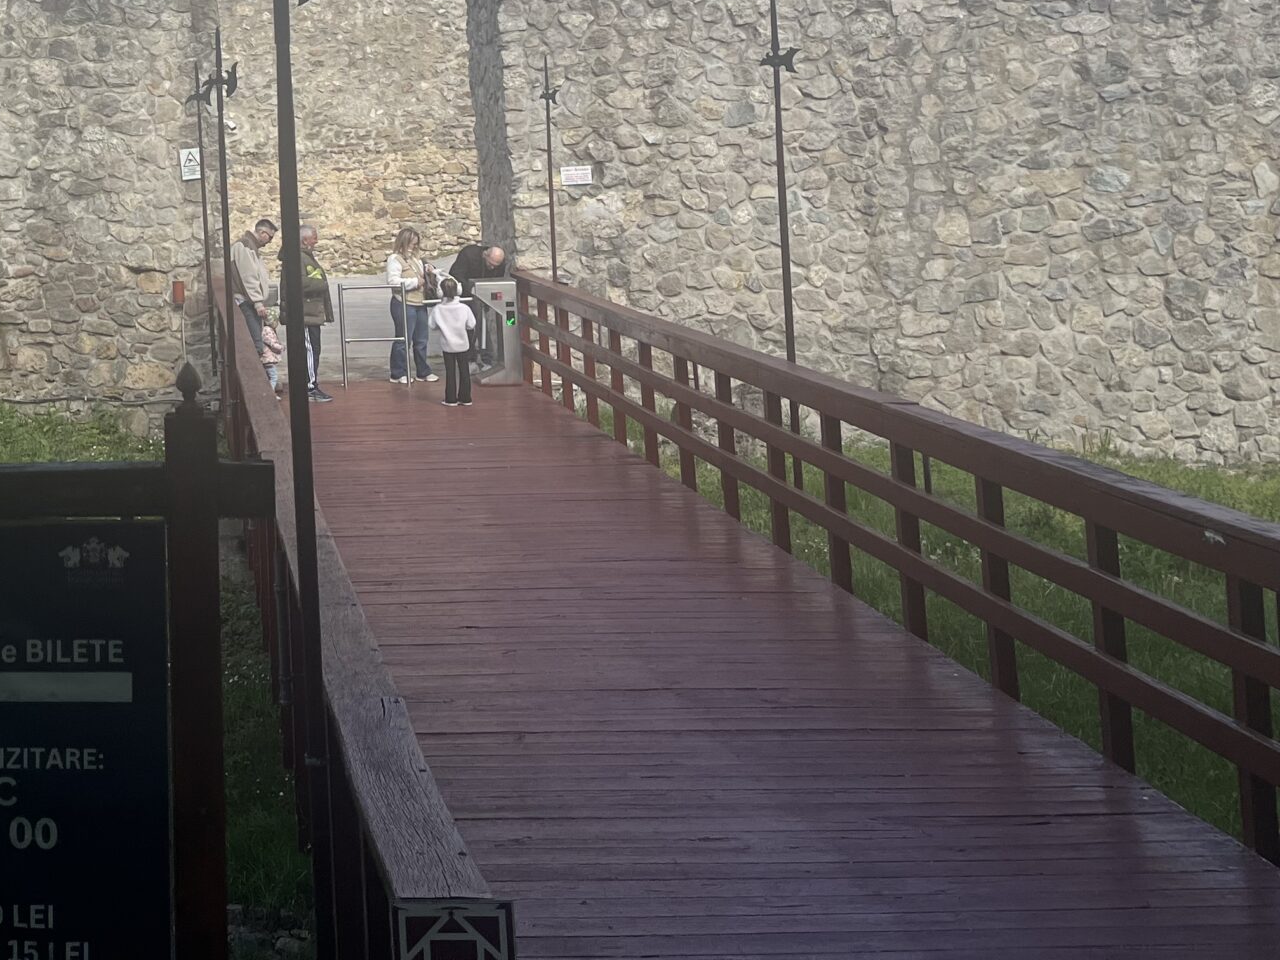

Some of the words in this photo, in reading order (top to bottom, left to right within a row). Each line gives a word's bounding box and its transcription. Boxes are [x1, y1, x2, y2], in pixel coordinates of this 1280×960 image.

[26, 639, 124, 663] BILETE
[13, 904, 54, 929] LEI
[7, 939, 39, 960] 15
